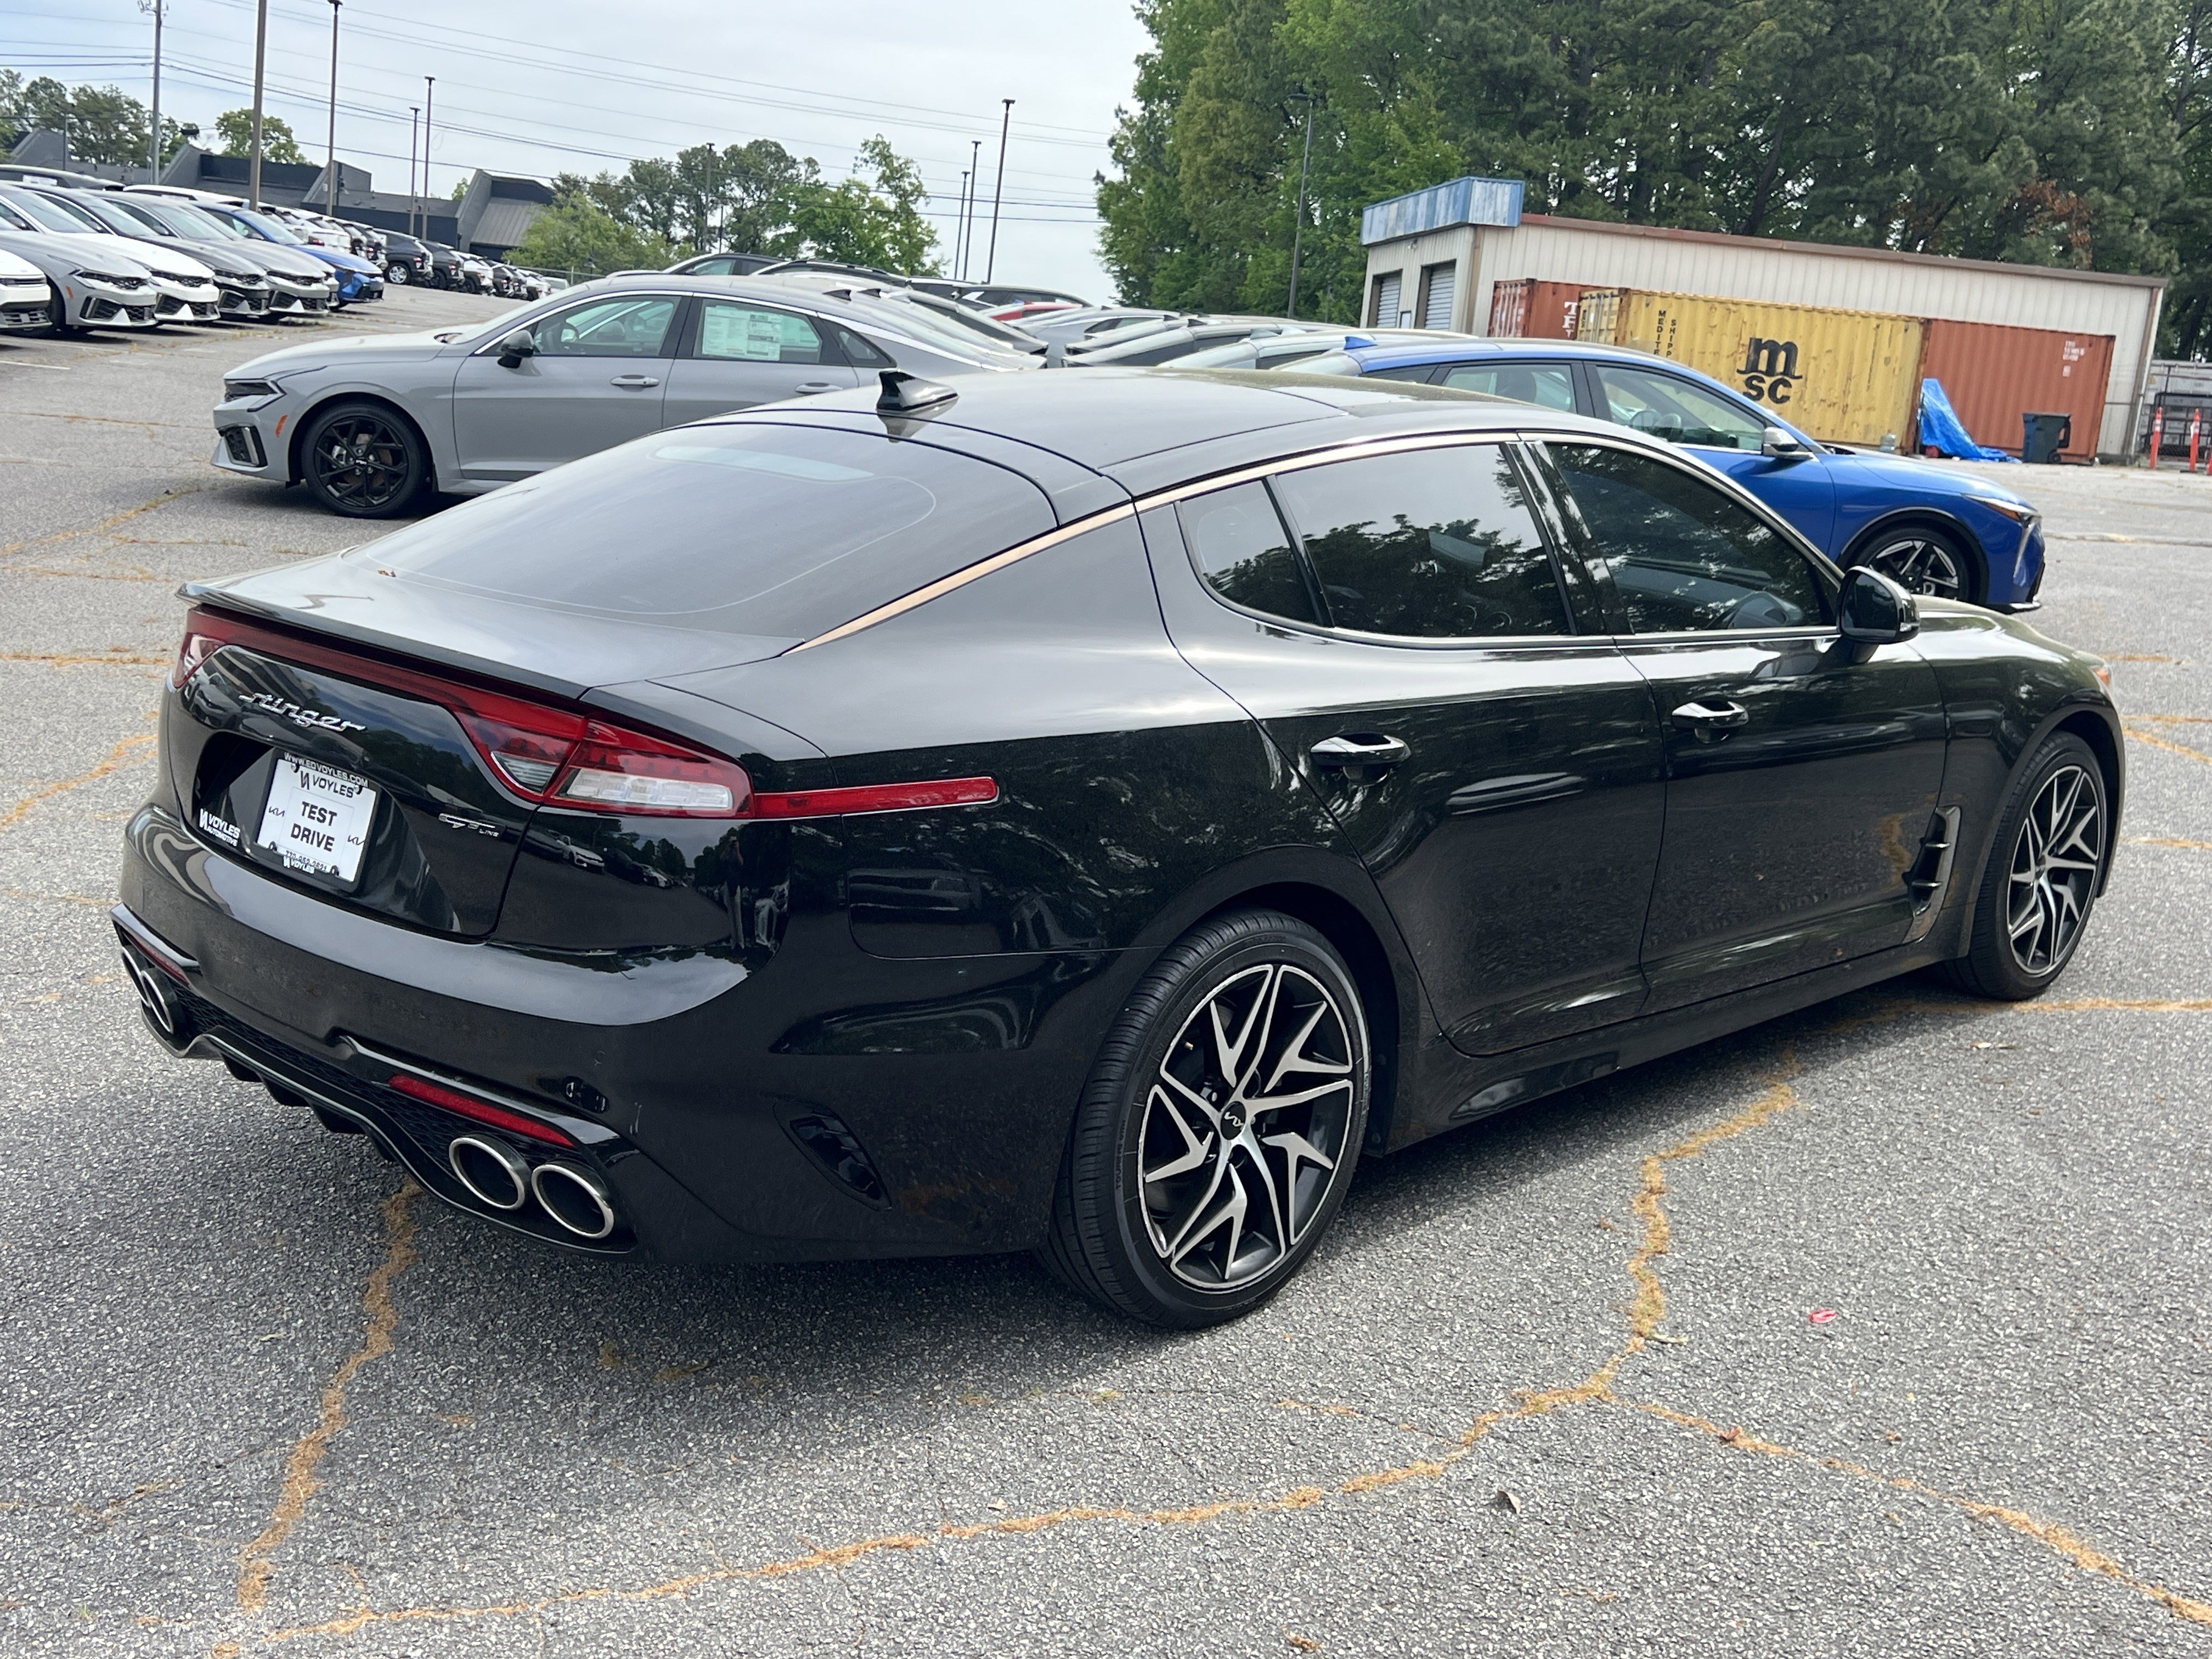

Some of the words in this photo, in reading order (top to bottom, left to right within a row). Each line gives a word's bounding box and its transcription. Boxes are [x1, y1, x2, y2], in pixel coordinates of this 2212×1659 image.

[312, 774, 354, 799] VOYLES
[208, 813, 241, 839] VOYLES
[301, 801, 337, 826] TEST
[290, 823, 335, 852] DRIVE
